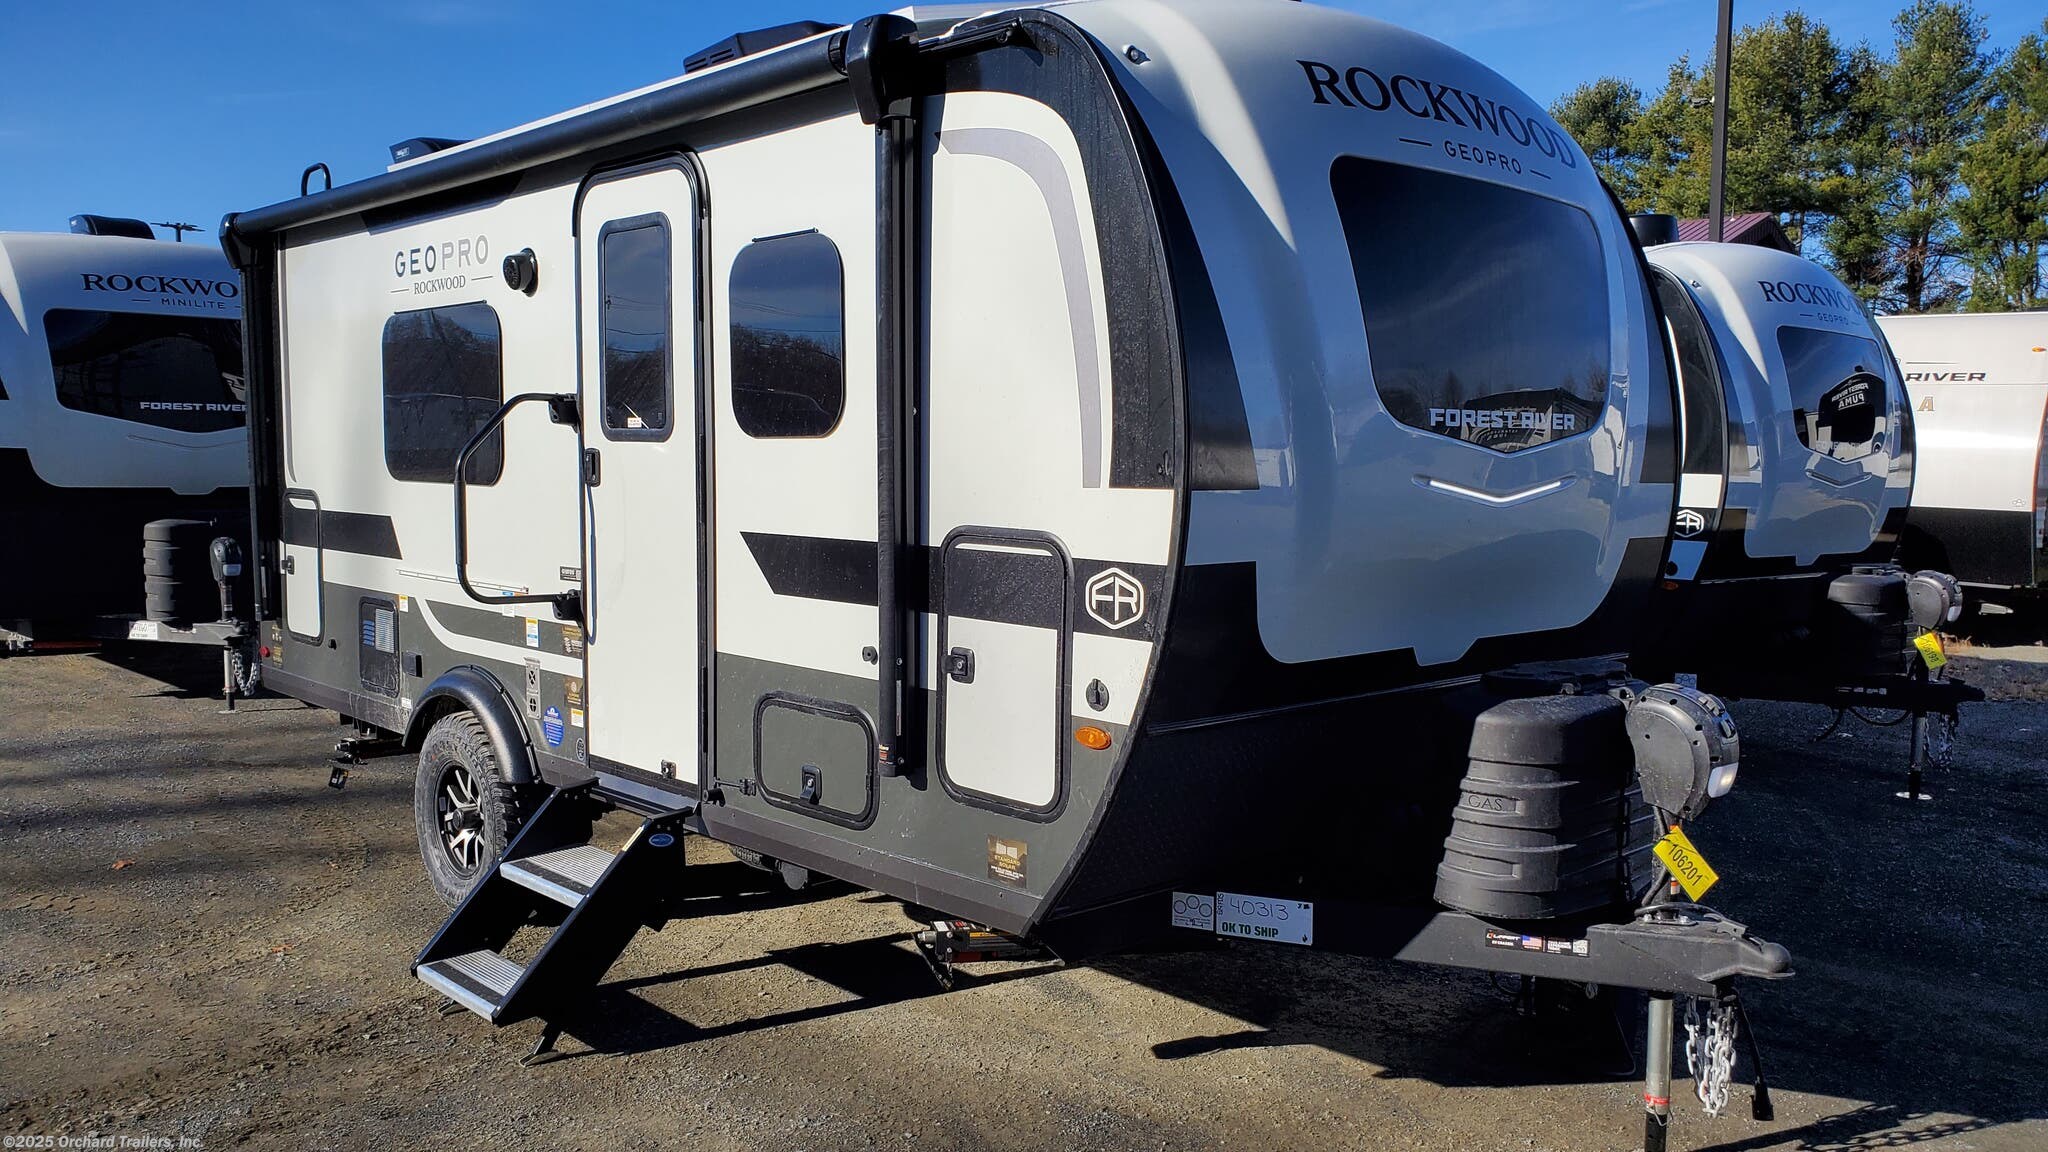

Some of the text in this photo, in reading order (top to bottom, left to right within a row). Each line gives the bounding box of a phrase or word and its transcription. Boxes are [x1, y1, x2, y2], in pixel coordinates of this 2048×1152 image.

[1295, 59, 1577, 169] ROCKWOOD
[1444, 140, 1522, 174] GEOPRO
[394, 235, 489, 277] GEOPRO
[414, 275, 466, 294] ROCKWOOD
[161, 298, 226, 309] MINILITE
[1905, 373, 1986, 382] RIVER
[140, 401, 203, 410] FOREST
[1429, 408, 1516, 429] FOREST
[1521, 410, 1576, 431] RIVER
[1468, 794, 1503, 811] GAS
[1668, 843, 1703, 886] 106201
[1229, 897, 1290, 921] 40313
[1221, 922, 1236, 933] OK
[1238, 923, 1252, 935] TO
[1254, 926, 1279, 938] SHIP
